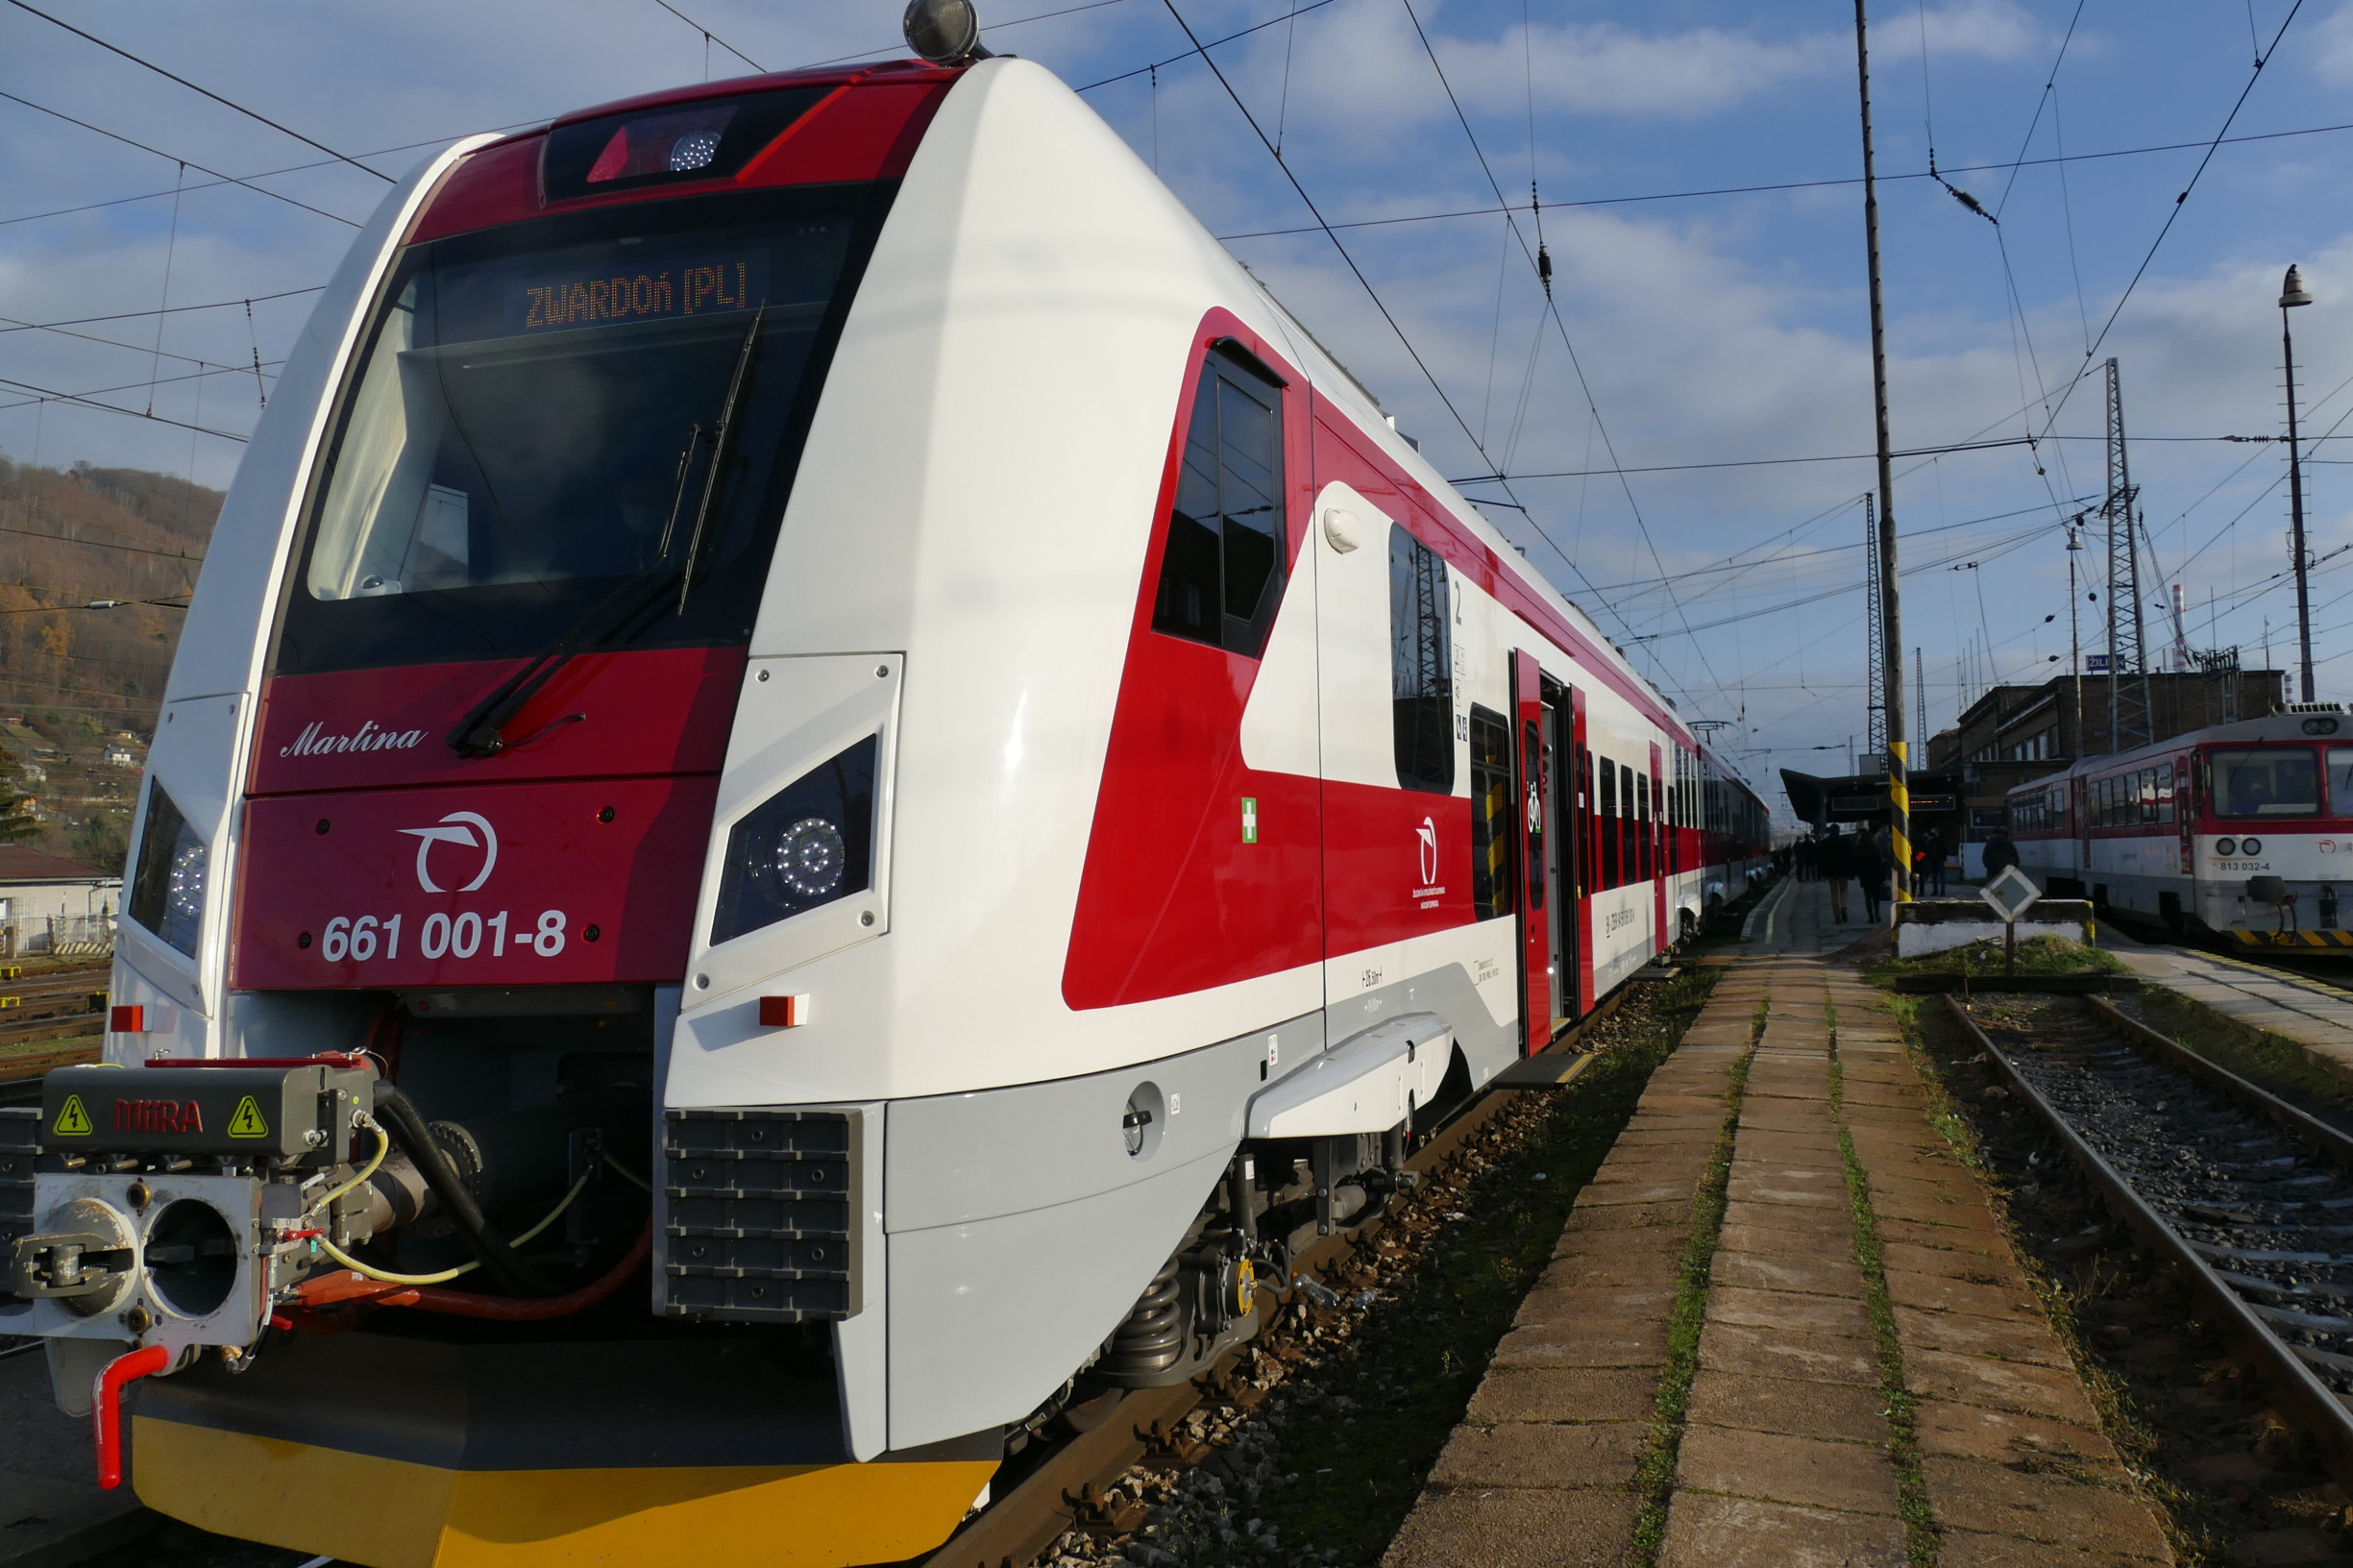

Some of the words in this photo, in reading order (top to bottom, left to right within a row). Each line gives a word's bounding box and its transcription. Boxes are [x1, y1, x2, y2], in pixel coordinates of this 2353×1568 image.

[1455, 580, 1462, 625] 2
[2089, 654, 2124, 667] ŽILIA
[280, 721, 429, 758] Martina
[2220, 862, 2239, 870] 813
[2242, 862, 2270, 870] 032-4
[322, 914, 402, 962] 661
[421, 910, 567, 959] 001-8
